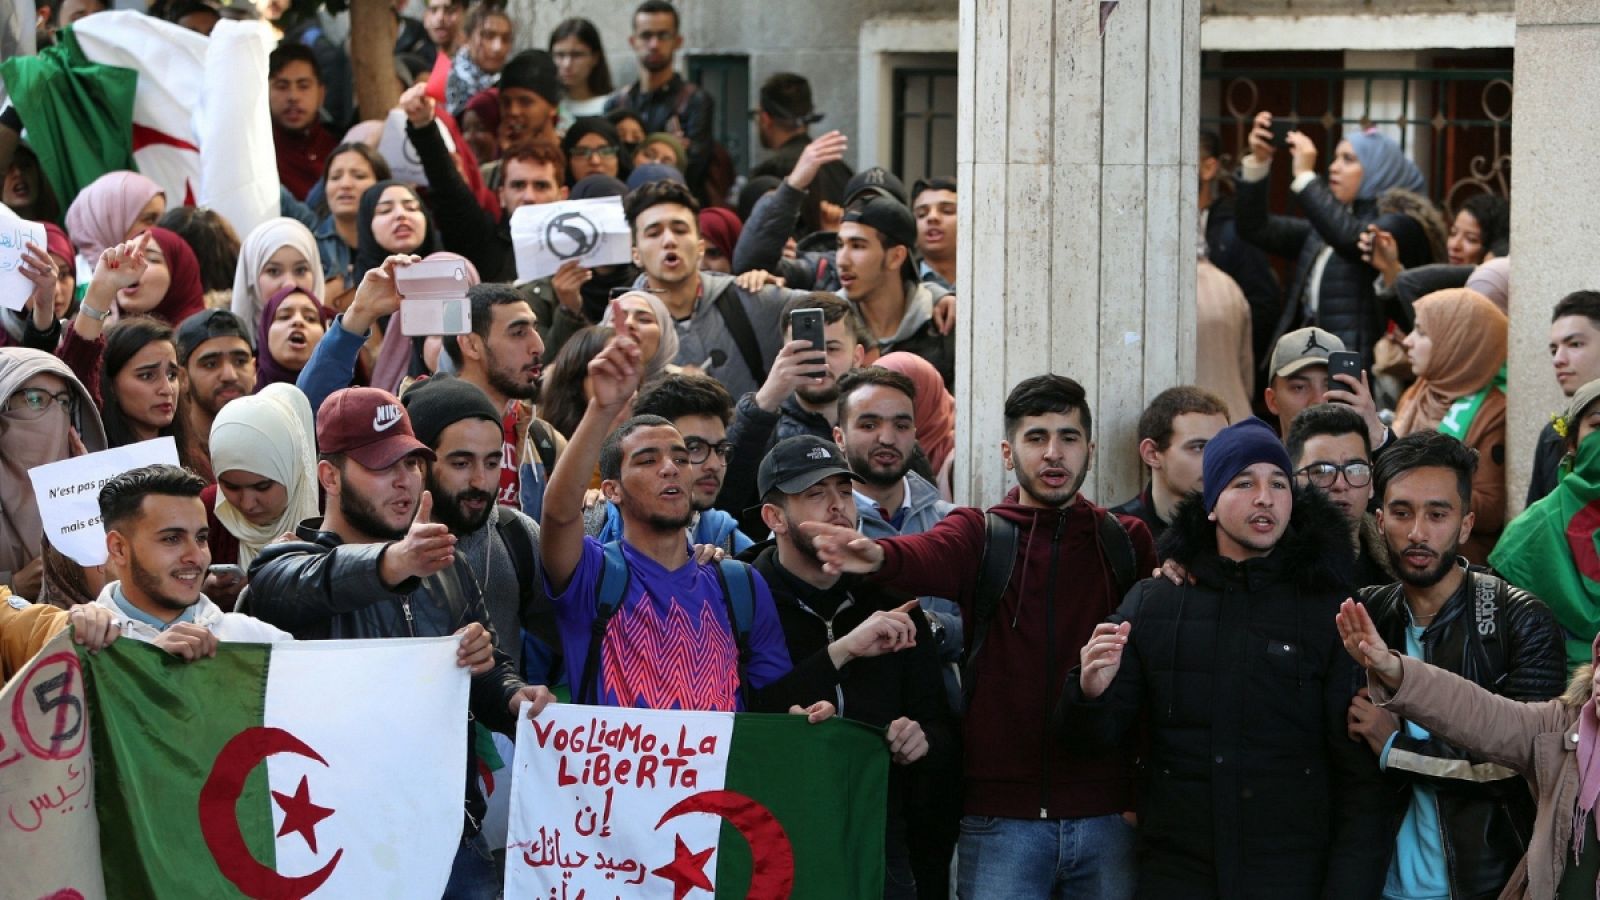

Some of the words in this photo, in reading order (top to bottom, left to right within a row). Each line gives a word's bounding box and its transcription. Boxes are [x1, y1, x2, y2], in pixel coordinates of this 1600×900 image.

[376, 404, 401, 422] NIKE
[48, 484, 75, 499] N'est
[77, 481, 96, 494] pas
[60, 519, 85, 534] mais
